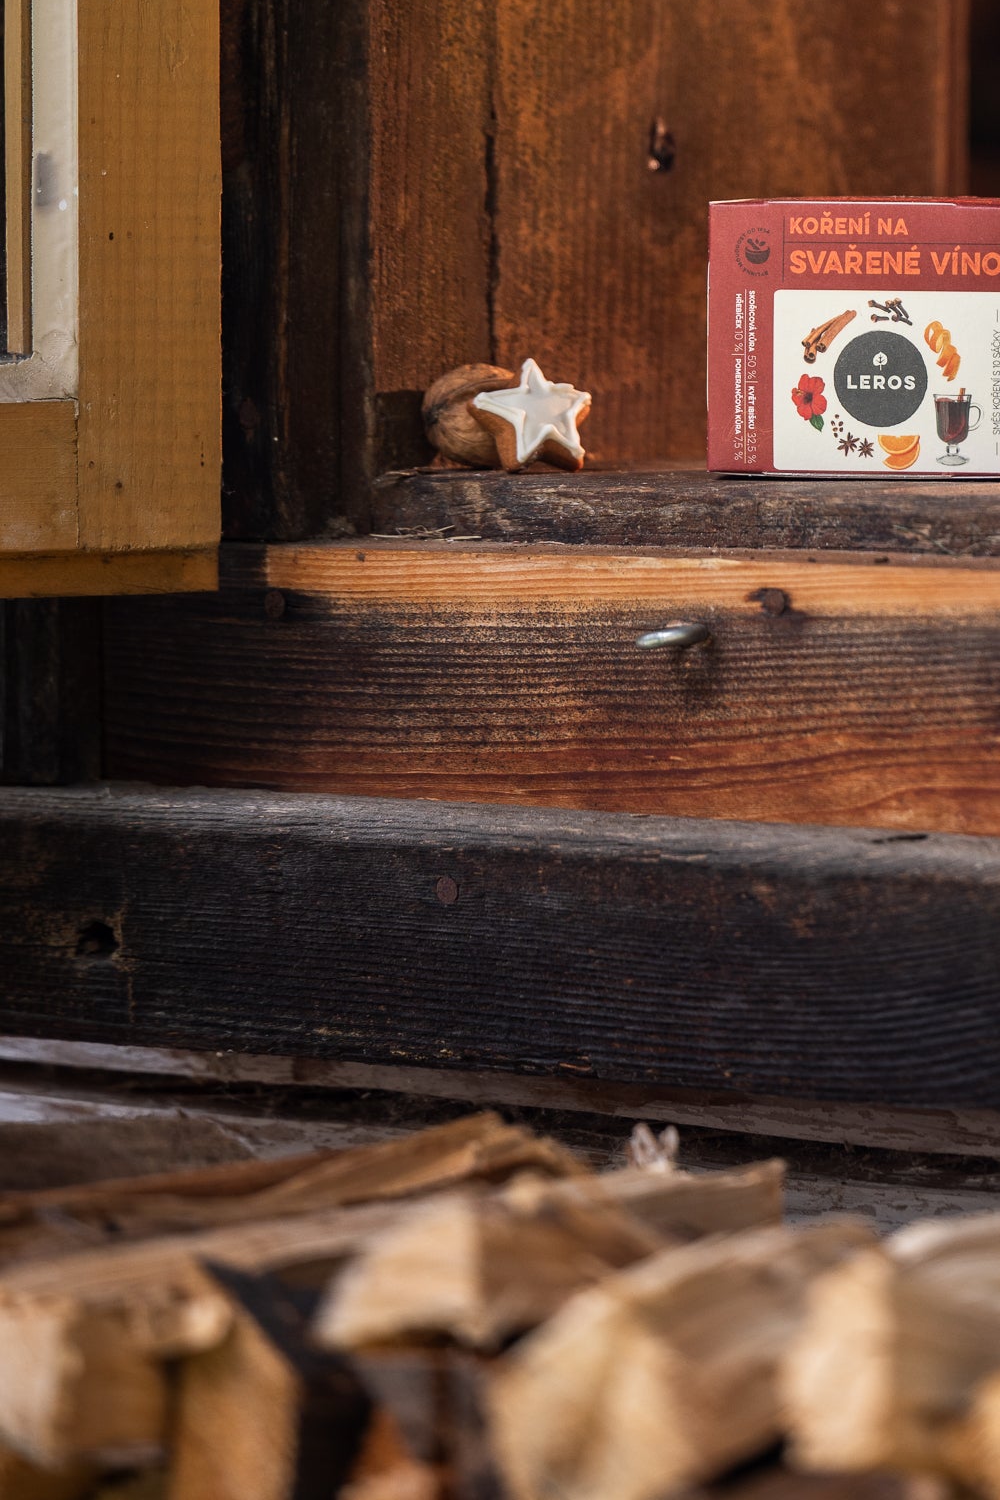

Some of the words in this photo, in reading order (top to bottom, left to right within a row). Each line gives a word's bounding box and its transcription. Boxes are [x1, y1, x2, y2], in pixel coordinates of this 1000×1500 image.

[789, 211, 871, 235] KOŘENÍ
[877, 217, 909, 235] NA
[789, 244, 921, 275] SVAŘENÉ
[735, 293, 744, 329] HŘEBÍČEK
[748, 290, 757, 331] SKOŘICOVÁ
[734, 330, 744, 340] 10
[990, 329, 1000, 359] SÁČKY
[734, 342, 744, 352] %
[747, 355, 757, 368] 50
[993, 361, 1000, 369] 10
[747, 370, 757, 380] %
[846, 374, 916, 390] LEROS
[734, 358, 743, 414] POMERANČOVÁ
[748, 386, 756, 405] KVĚT
[990, 377, 1000, 410] KOŘENÍ
[748, 406, 756, 430] IBIŠKU
[990, 411, 1000, 435] SMĚS
[733, 436, 743, 449] 7,5
[734, 451, 743, 461] %
[747, 454, 757, 464] %
